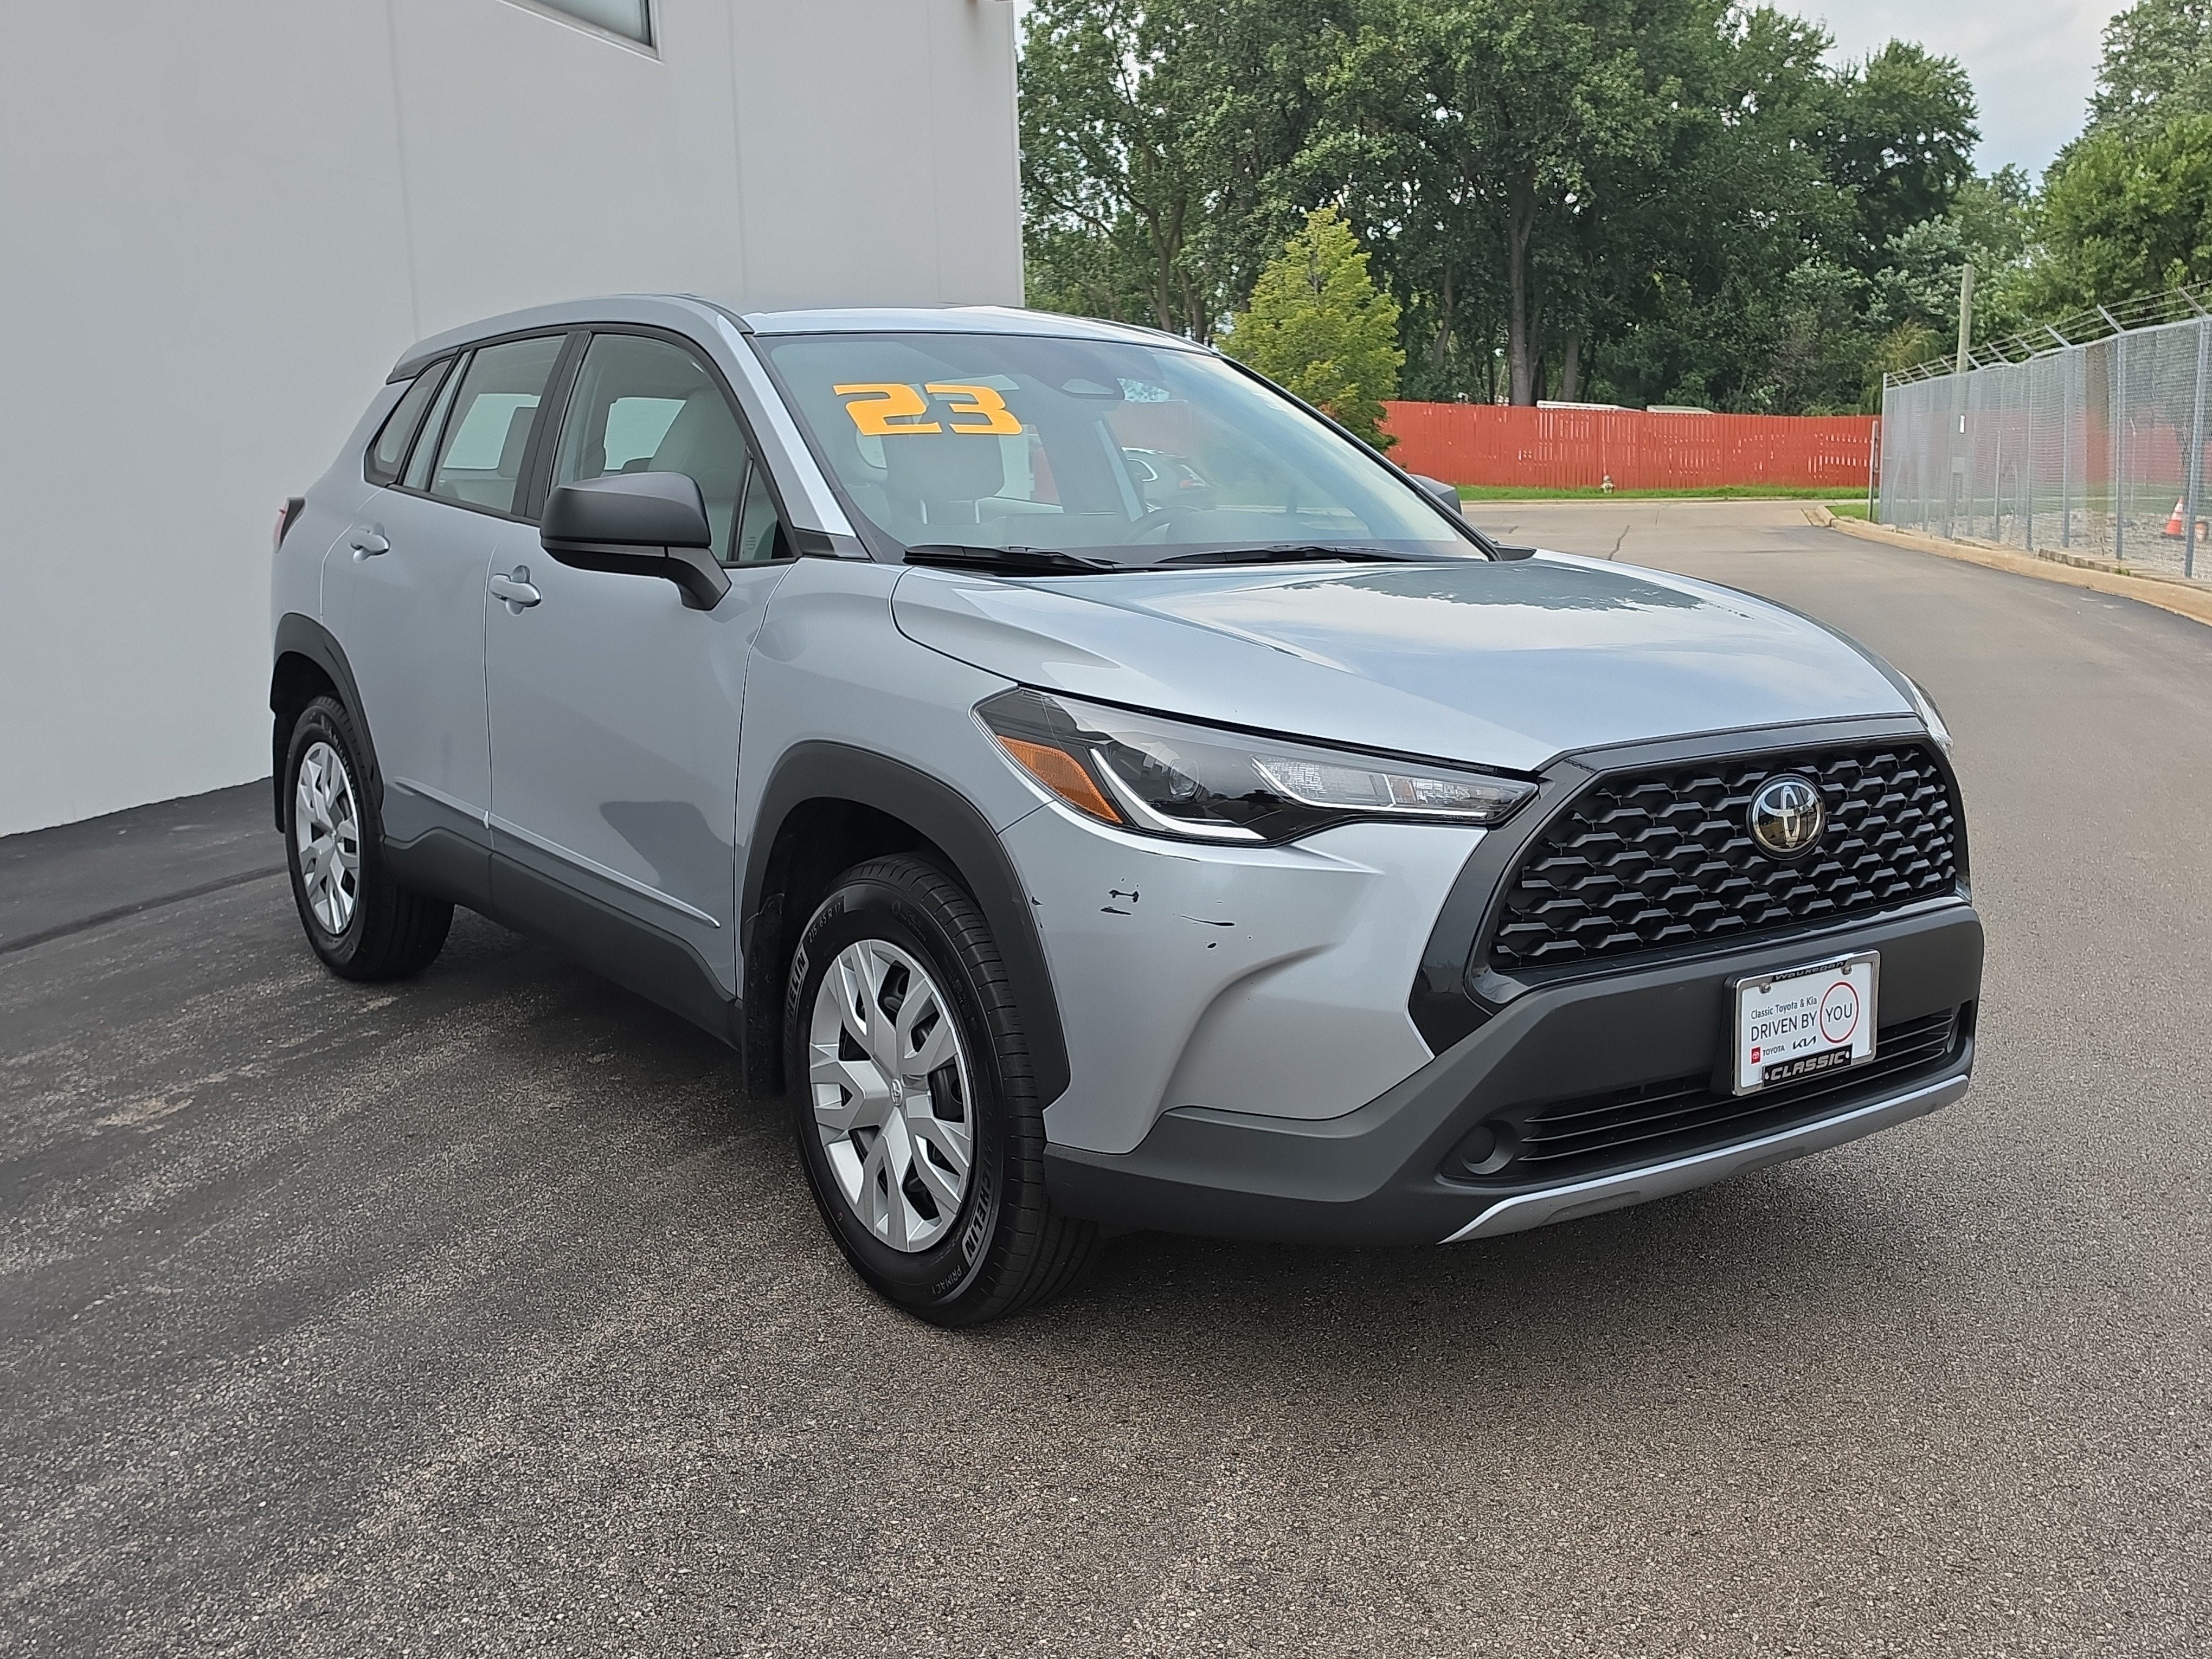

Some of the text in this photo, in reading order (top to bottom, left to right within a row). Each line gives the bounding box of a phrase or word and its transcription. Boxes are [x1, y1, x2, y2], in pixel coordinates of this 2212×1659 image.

[833, 383, 1023, 435] 23
[808, 902, 841, 944] 215 65 R 17
[1776, 962, 1844, 981] Waukegan
[1751, 996, 1817, 1020] Classic Toyota & Kia
[1751, 1003, 1853, 1041] DRIVEN BY YOU
[1763, 1045, 1785, 1057] TOYOTA
[1771, 1051, 1845, 1081] CLASSIC
